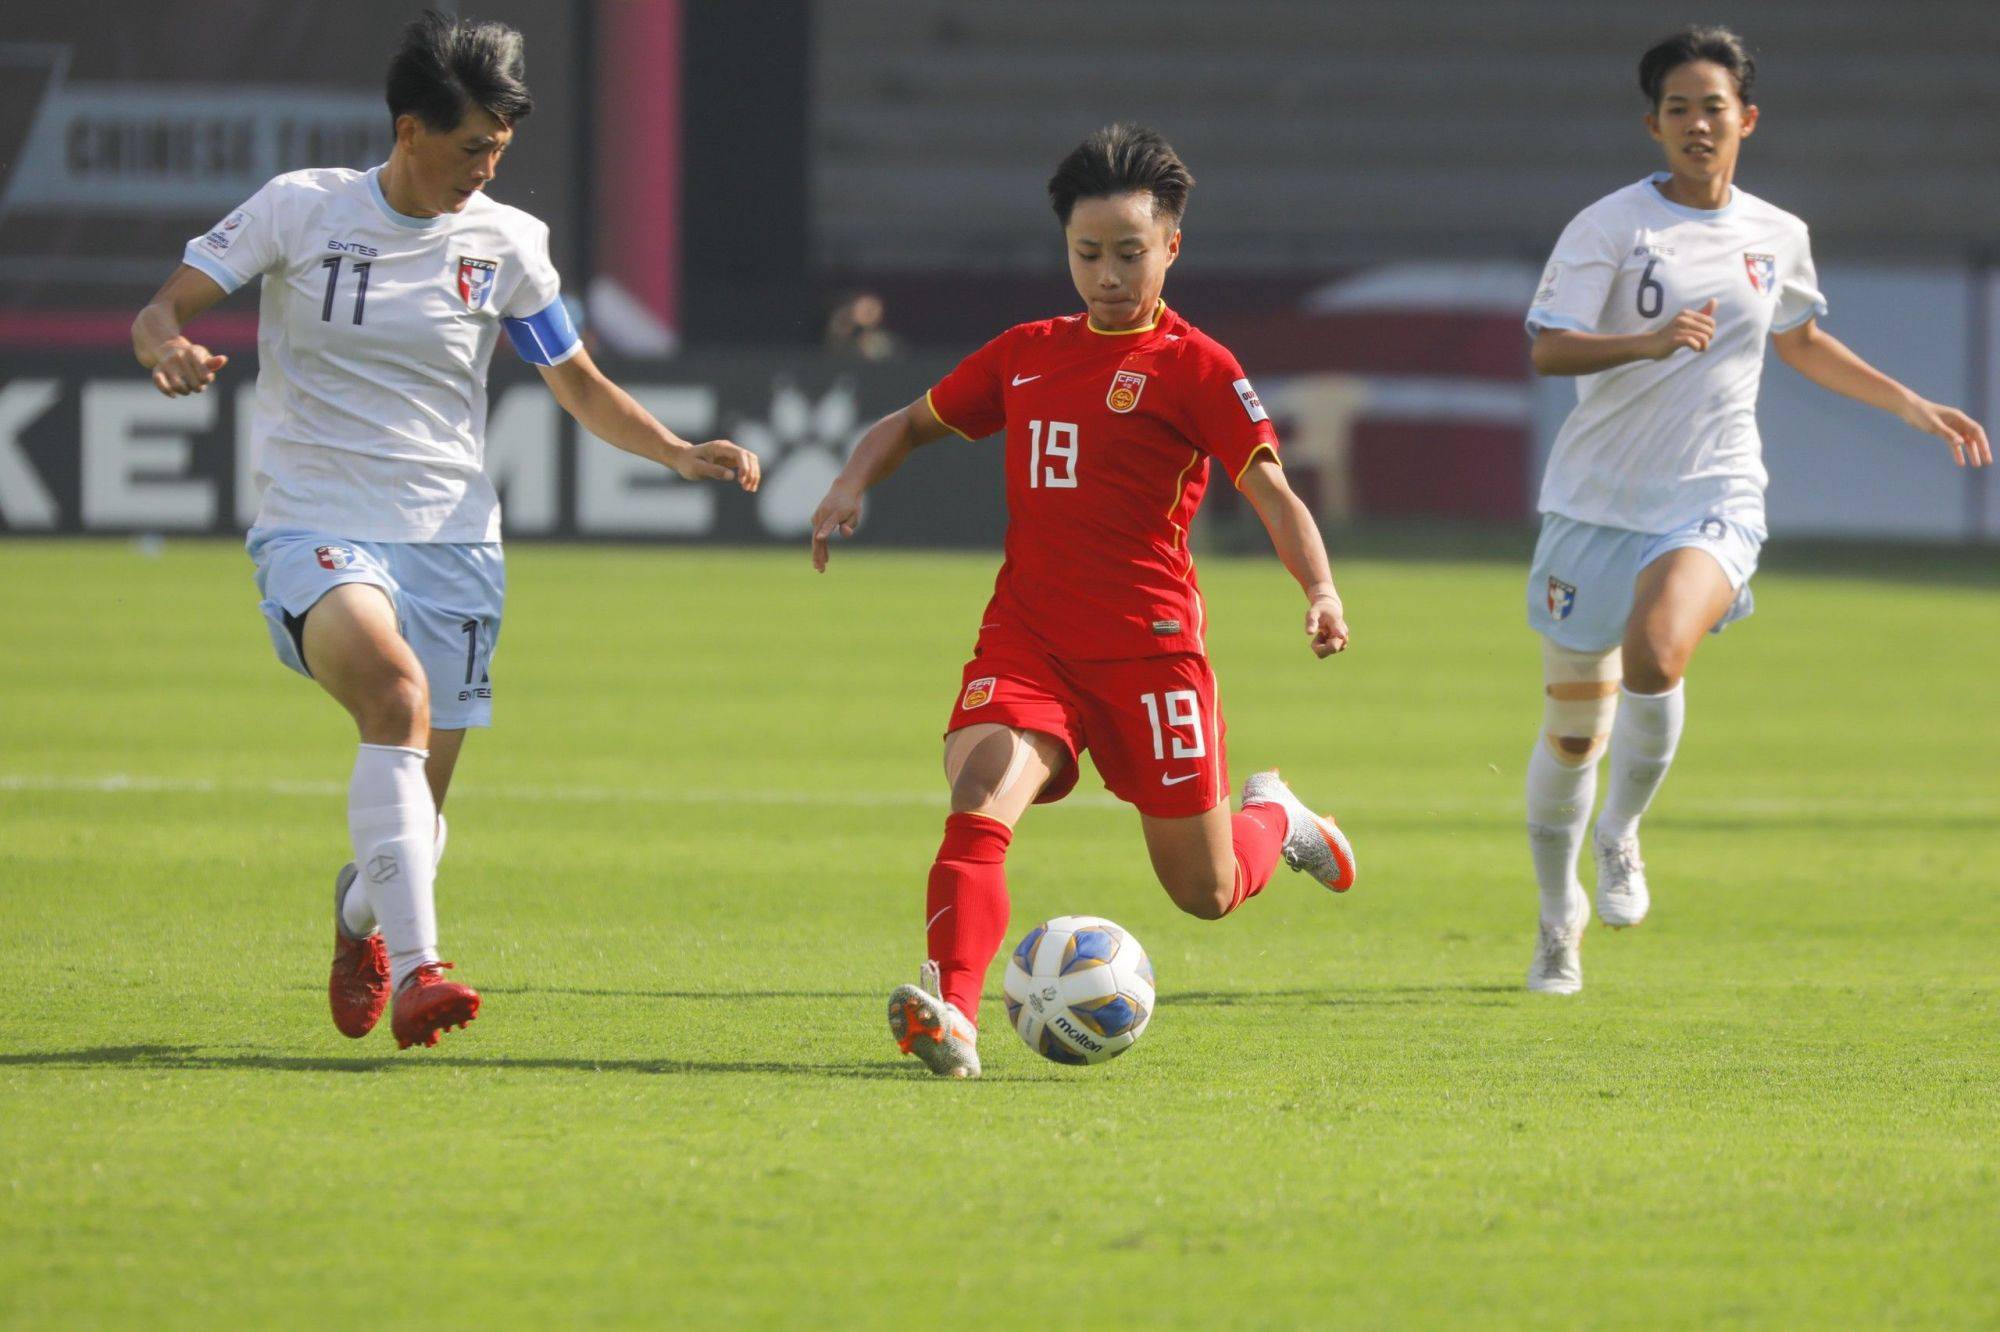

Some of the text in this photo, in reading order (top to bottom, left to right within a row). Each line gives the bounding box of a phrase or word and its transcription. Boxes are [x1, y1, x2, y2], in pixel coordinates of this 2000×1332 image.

[328, 240, 377, 257] ENTES
[322, 257, 372, 325] 11
[1636, 259, 1664, 319] 6
[1118, 374, 1142, 385] CFA
[1028, 420, 1079, 489] 19
[1140, 690, 1206, 760] 19
[1056, 1017, 1103, 1053] molten
